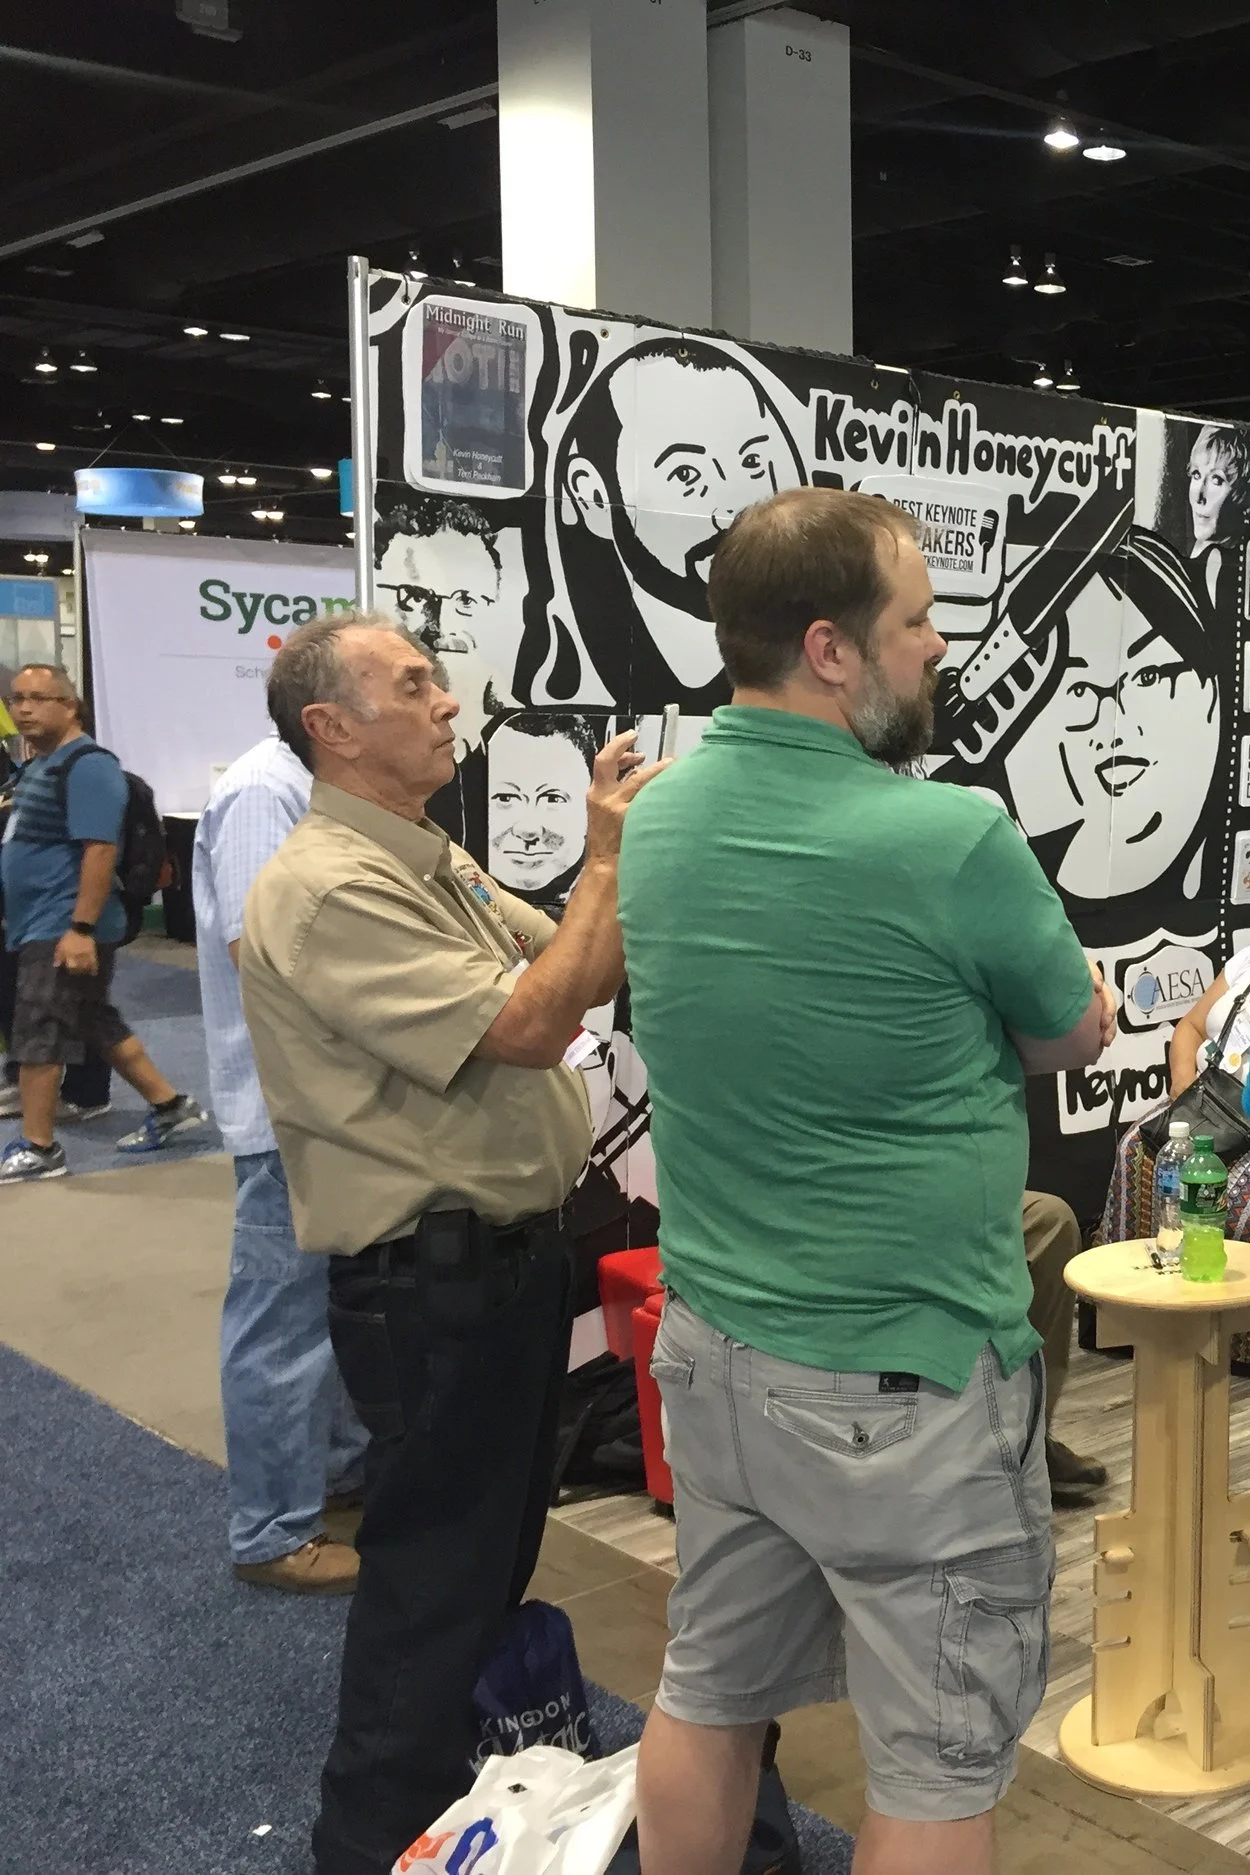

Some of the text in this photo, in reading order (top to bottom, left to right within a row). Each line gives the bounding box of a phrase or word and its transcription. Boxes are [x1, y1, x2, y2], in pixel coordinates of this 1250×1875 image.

[785, 45, 812, 62] D-33
[426, 304, 492, 333] Midnight
[499, 322, 525, 340] Run
[815, 395, 942, 468] Kevin
[925, 503, 977, 527] KEYNOTE
[918, 526, 976, 557] AKERS
[923, 555, 974, 571] TKEYNOTE.COM
[199, 579, 356, 634] Syca
[1150, 967, 1206, 1005] AESA
